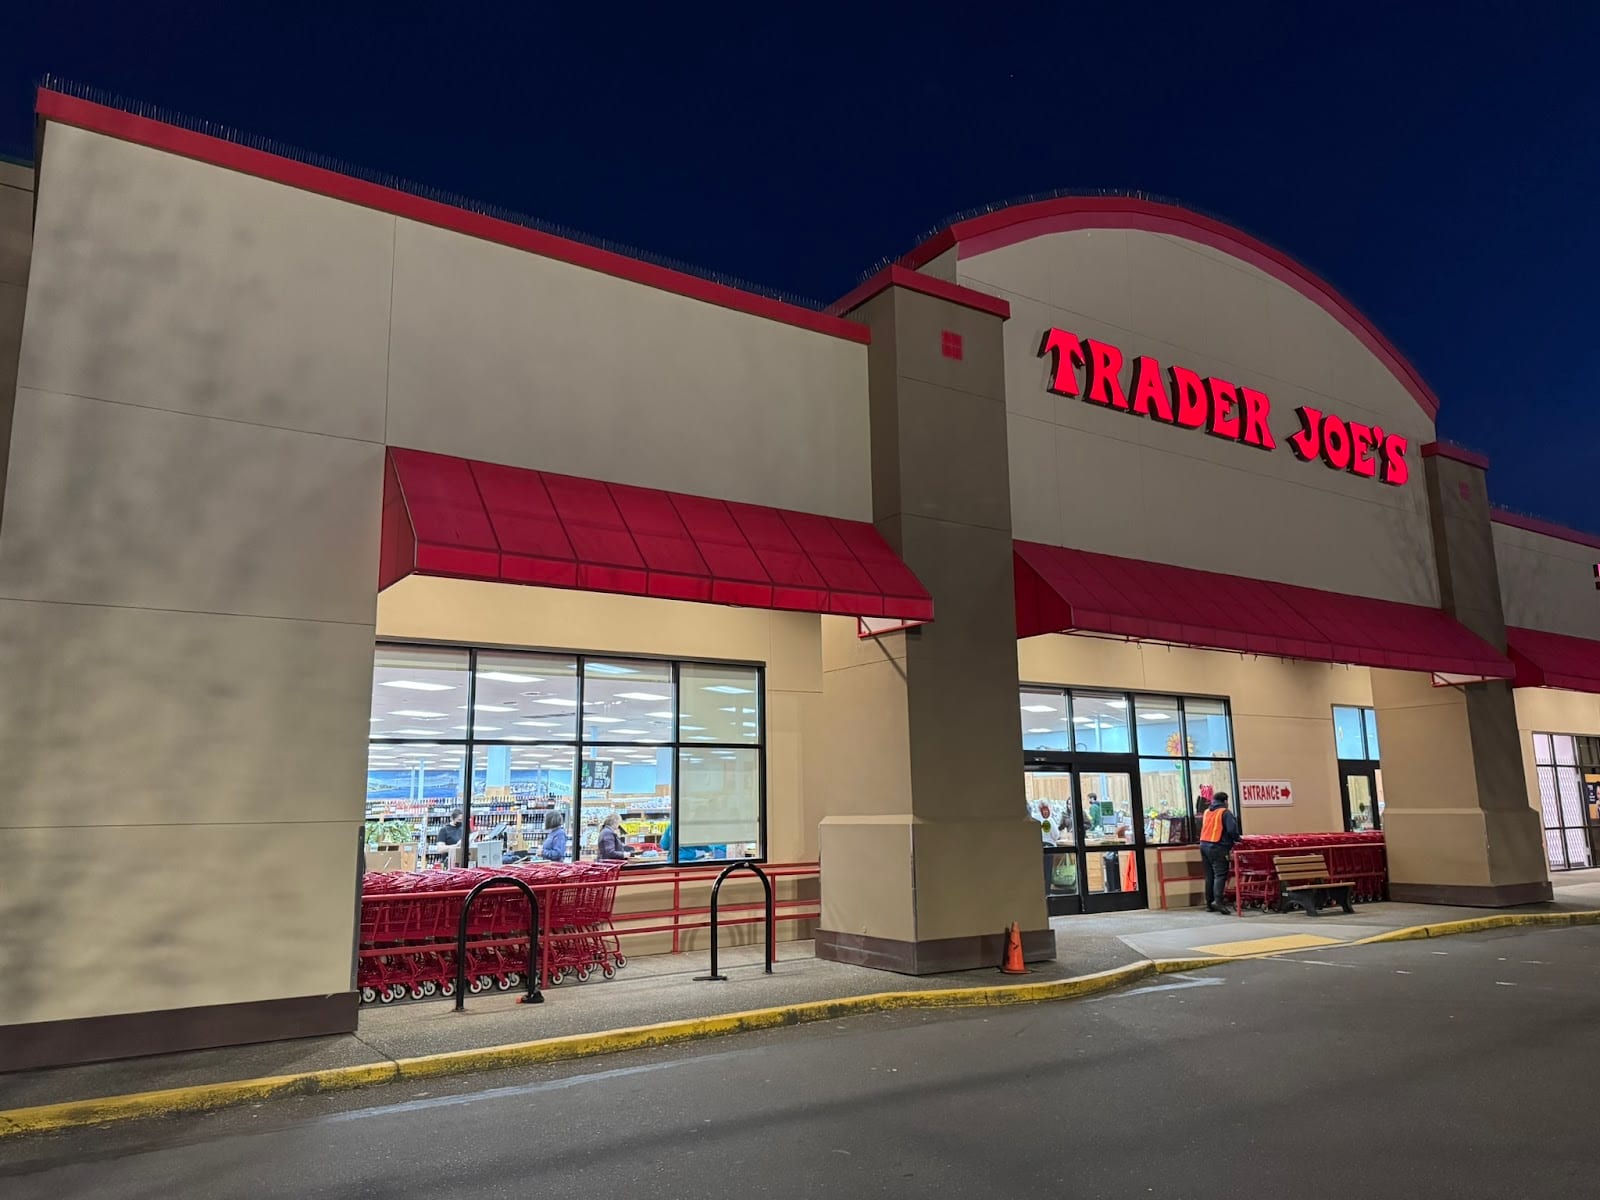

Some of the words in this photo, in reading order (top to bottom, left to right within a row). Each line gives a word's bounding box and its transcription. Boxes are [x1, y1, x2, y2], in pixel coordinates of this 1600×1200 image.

[1042, 327, 1276, 449] TRADER
[1290, 406, 1408, 485] JOE'S
[1242, 785, 1280, 801] ENTRANCE
